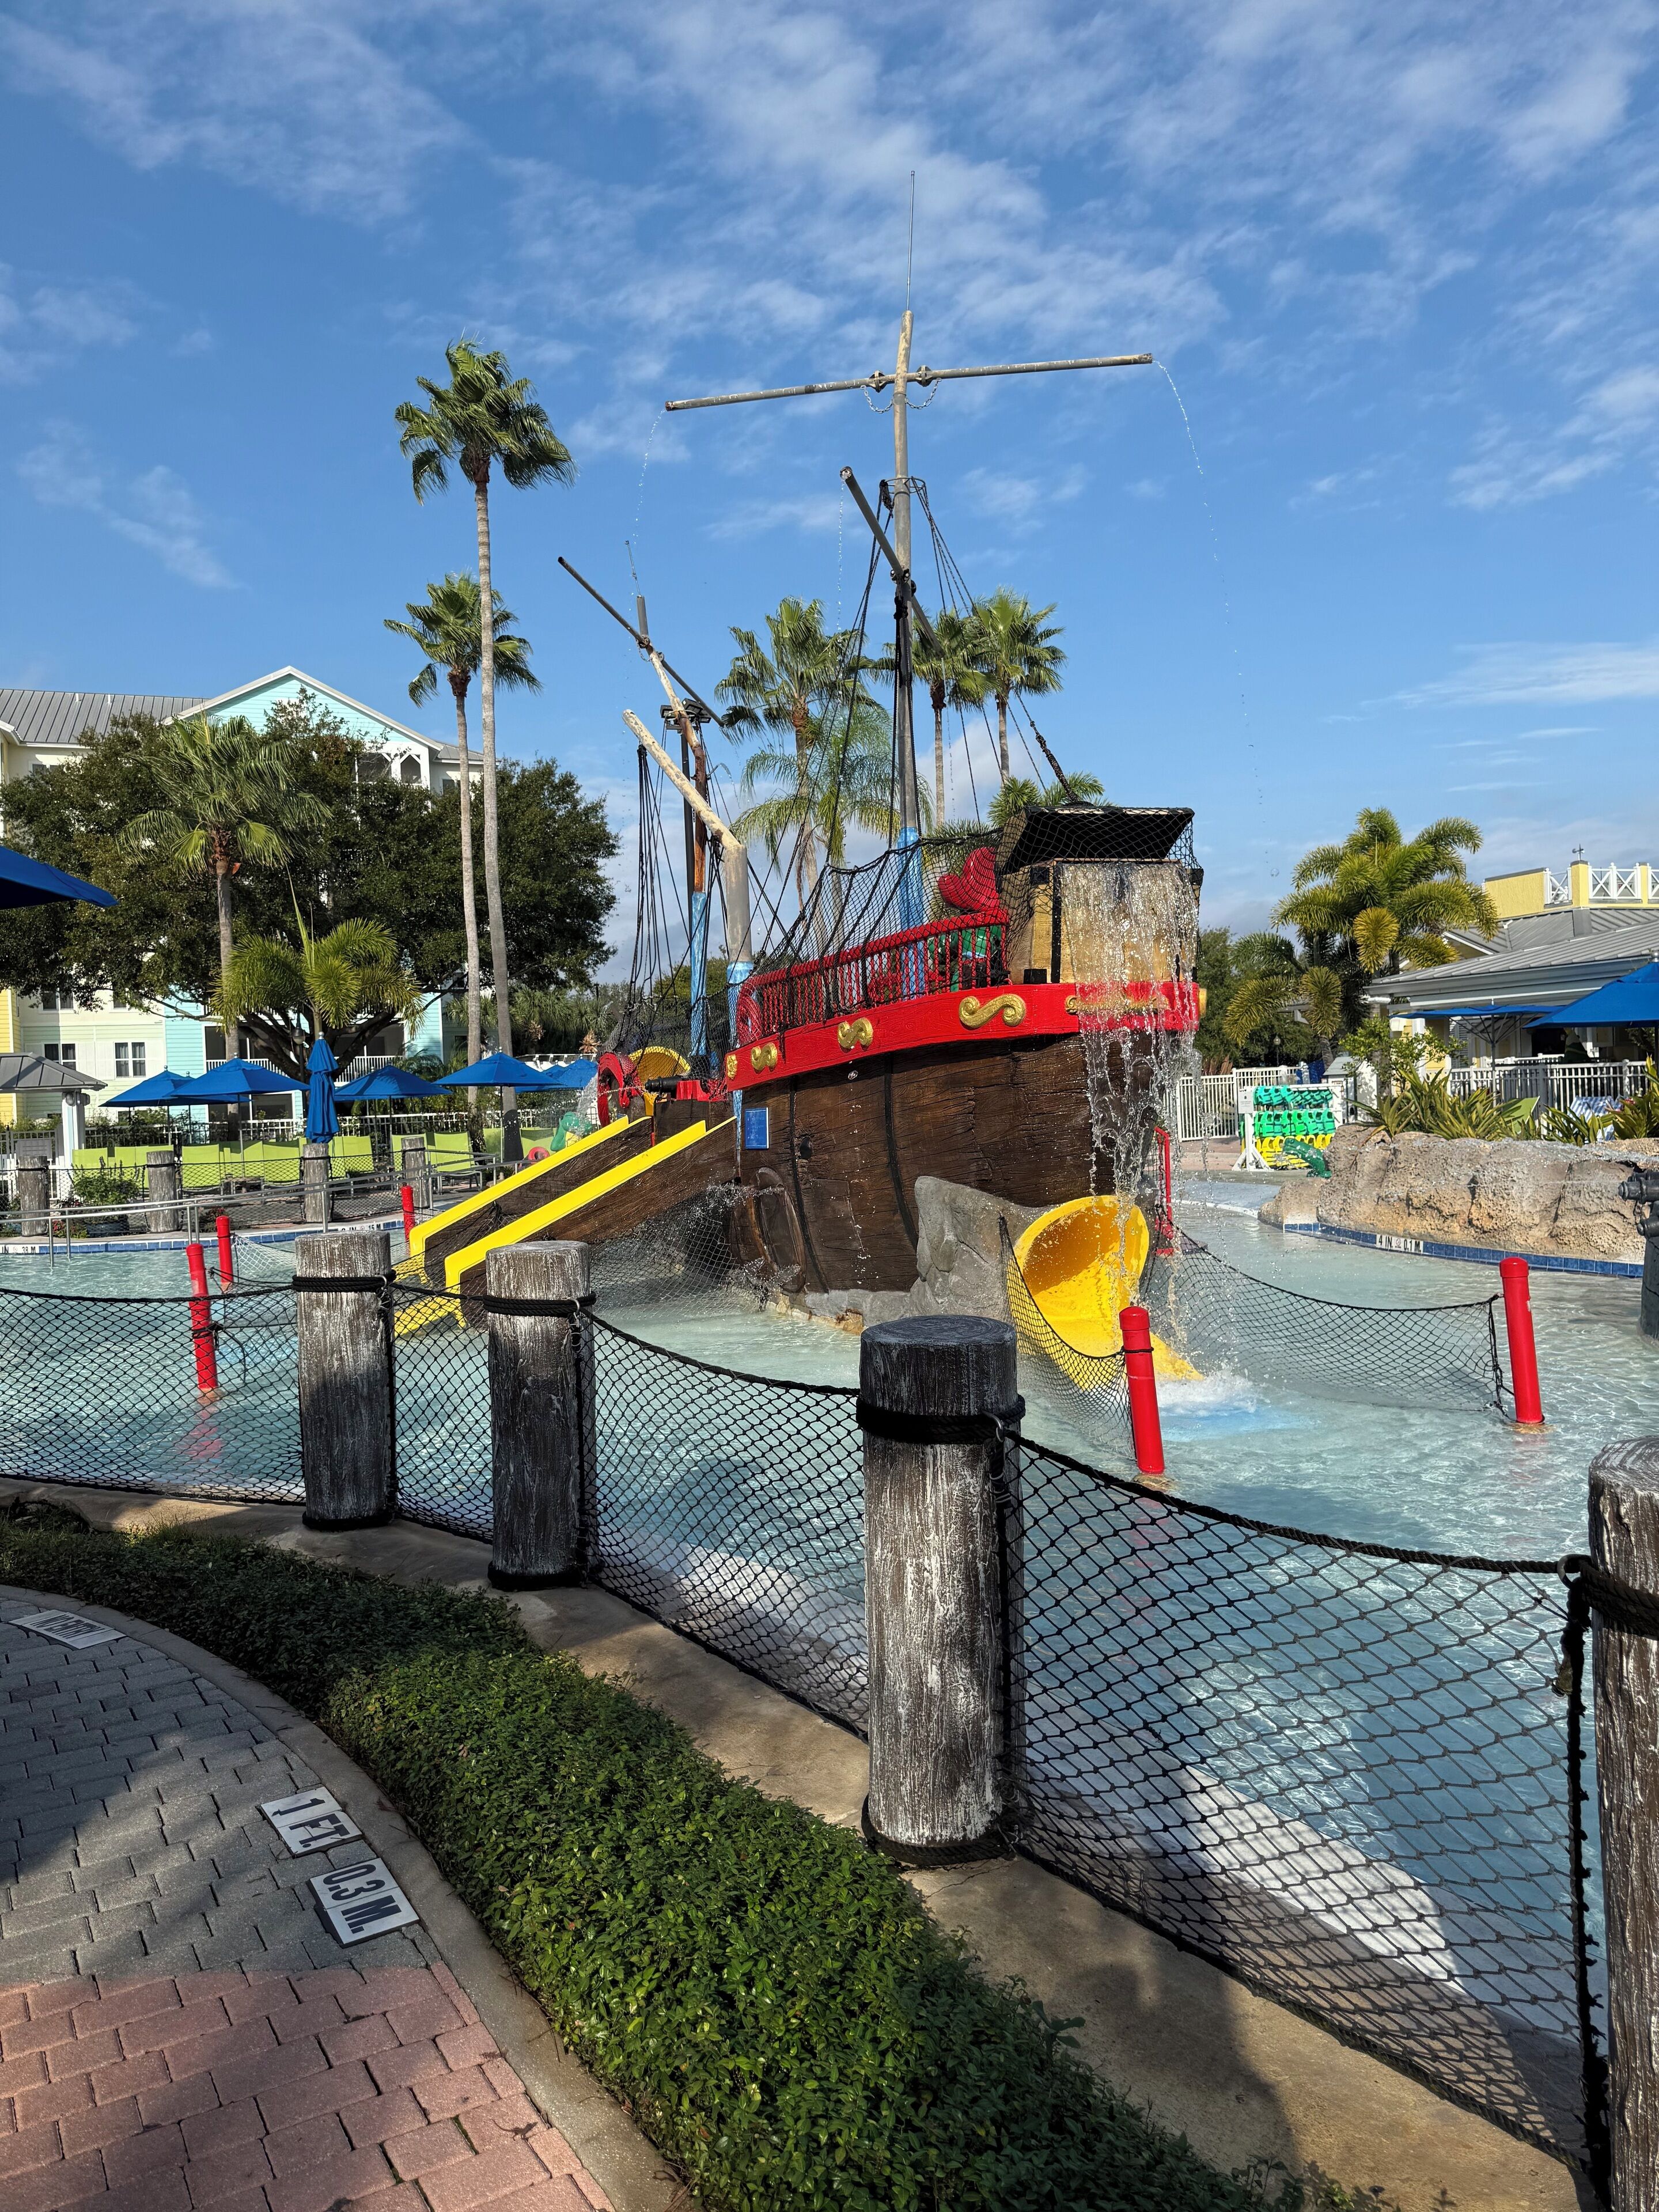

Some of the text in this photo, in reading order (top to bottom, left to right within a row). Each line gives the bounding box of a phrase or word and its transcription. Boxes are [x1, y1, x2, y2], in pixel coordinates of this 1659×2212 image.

[1378, 1235, 1382, 1245] 4
[1403, 1238, 1412, 1251] 0.1
[1414, 1240, 1422, 1252] M.
[29, 1613, 105, 1639] NO ENTRY
[276, 1797, 350, 1848] 1 FT.
[323, 1863, 402, 1934] 0.3 M.
